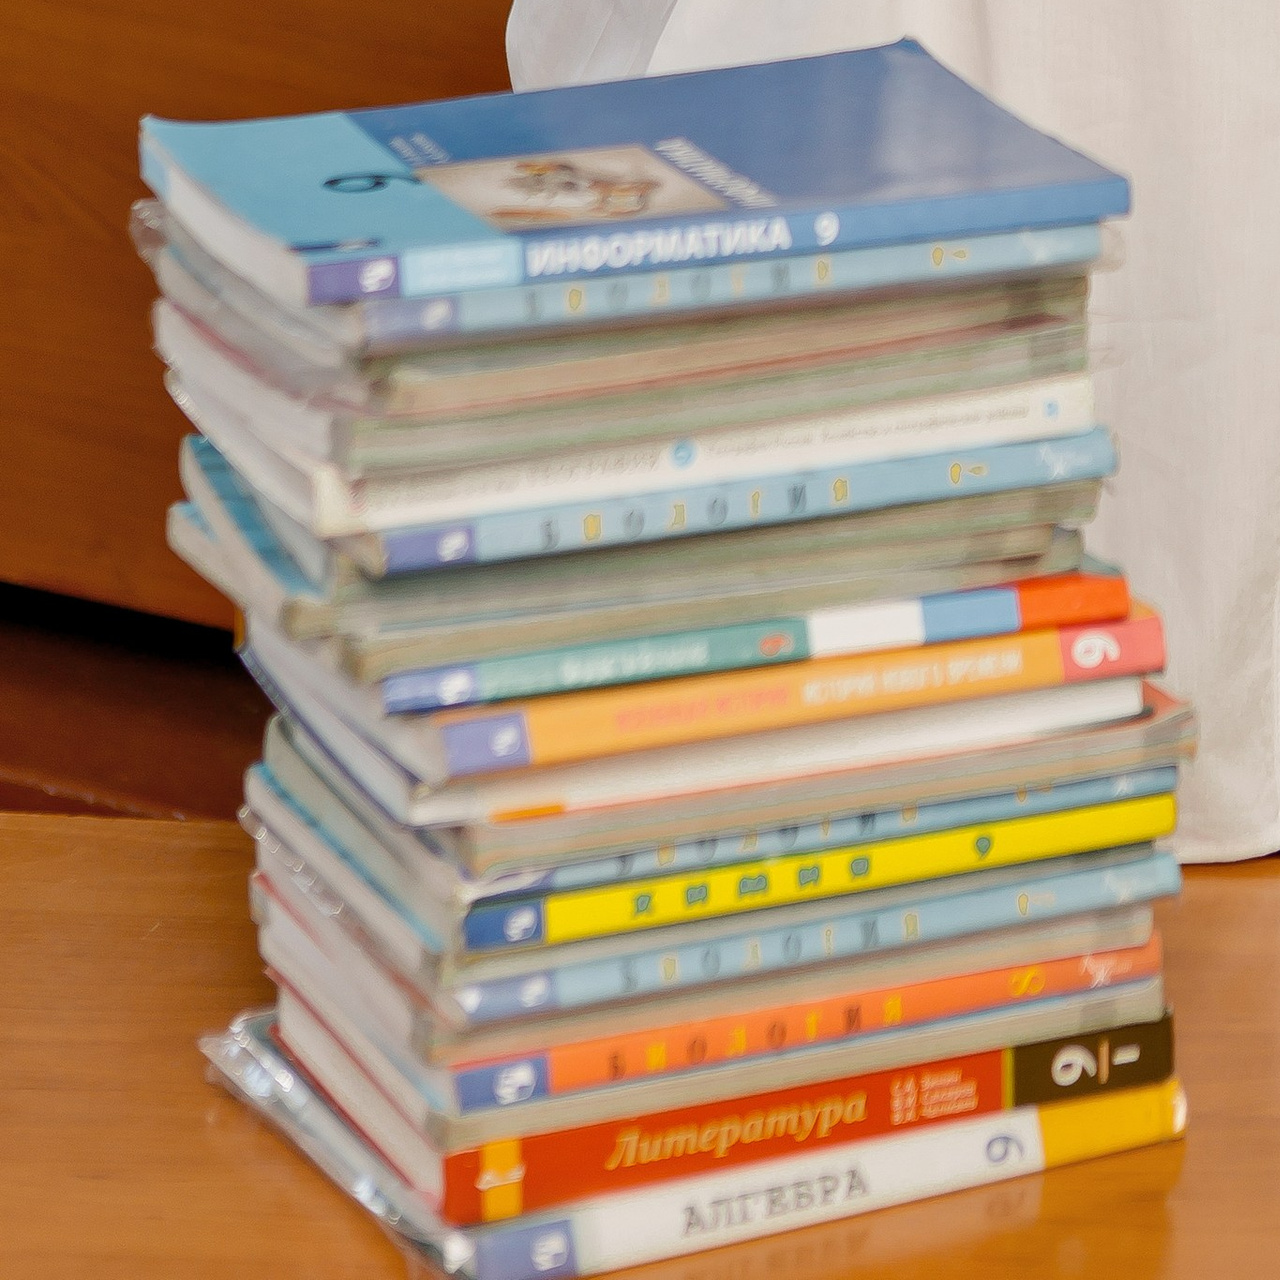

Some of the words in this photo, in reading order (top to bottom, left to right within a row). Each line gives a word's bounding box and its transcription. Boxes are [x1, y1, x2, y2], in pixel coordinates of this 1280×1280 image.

[526, 216, 792, 278] ИНФОРМАТИКА
[813, 211, 841, 246] 9
[604, 1090, 868, 1170] Литература
[682, 1167, 870, 1239] АЛГЕБРА
